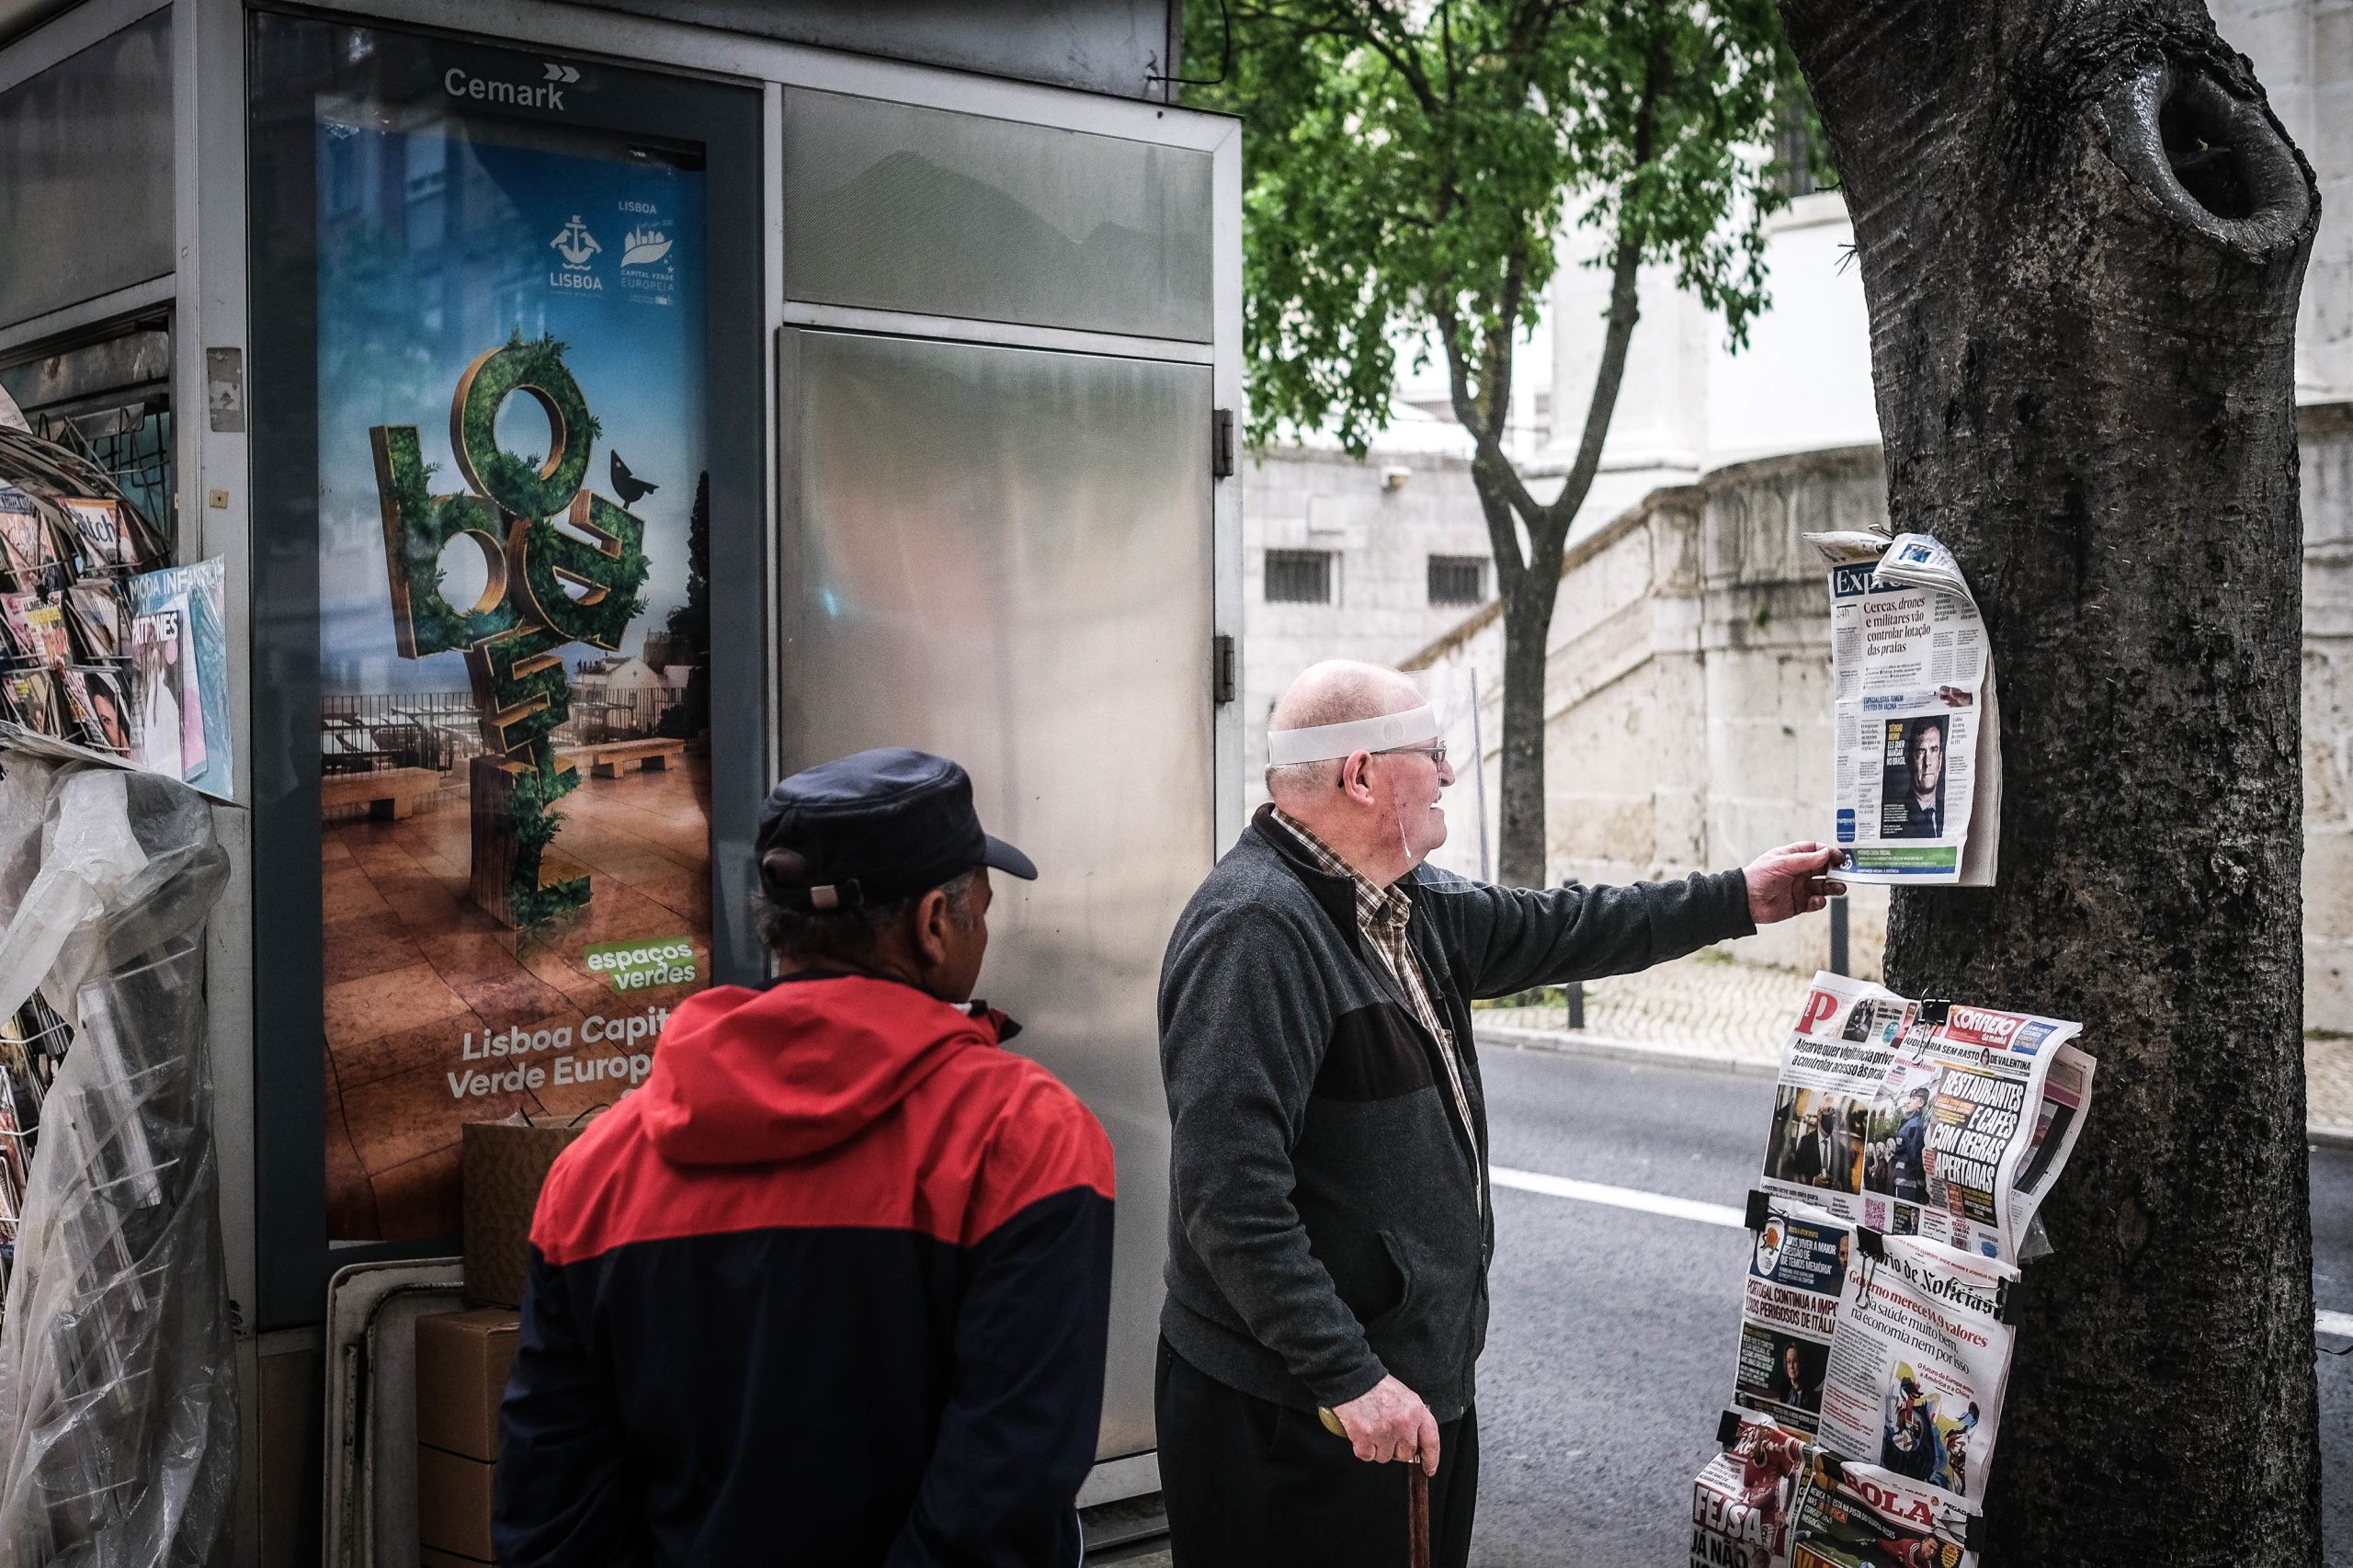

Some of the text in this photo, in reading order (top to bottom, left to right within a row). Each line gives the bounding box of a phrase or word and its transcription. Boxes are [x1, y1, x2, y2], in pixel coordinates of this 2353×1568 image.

[445, 67, 564, 111] Cemark
[619, 200, 657, 214] LISBOA
[550, 272, 603, 290] LISBOA
[129, 576, 161, 601] MODA
[1863, 600, 1898, 614] Cercas,
[1899, 596, 1926, 609] drones
[1866, 610, 1925, 628] e militares vão
[1867, 623, 1931, 642] controlar lotação
[1867, 641, 1907, 656] das praias
[587, 942, 693, 971] espaços
[614, 964, 697, 991] verdes
[1794, 990, 1838, 1035] P
[1954, 1007, 2017, 1037] CORREIO
[462, 1025, 573, 1061] Lisboa
[1793, 1038, 1823, 1054] Algarve
[1821, 1043, 1841, 1059] quer
[1839, 1045, 1874, 1062] vigilância
[1792, 1056, 1797, 1066] a
[1796, 1054, 1834, 1073] controlar
[1832, 1062, 1858, 1075] acesso
[1857, 1064, 1868, 1078] às
[1941, 1044, 1959, 1056] SEM
[1957, 1049, 1980, 1062] RASTO
[1989, 1055, 1998, 1065] DE
[1997, 1056, 2031, 1071] VALENTINA
[447, 1052, 654, 1099] Verde Europ
[1940, 1070, 2024, 1113] RESTAURANTES
[1967, 1105, 1984, 1130] E
[1975, 1108, 2018, 1140] CAFÉS
[1931, 1122, 1962, 1153] COM
[1956, 1129, 2006, 1165] REGRAS
[1934, 1152, 1995, 1194] APERTADAS
[1788, 1256, 1805, 1269] TEMOS
[1818, 1242, 1836, 1256] MAIOR
[1904, 1259, 1919, 1283] de
[1747, 1278, 1773, 1301] PORTUGAL
[1774, 1288, 1810, 1310] CONTINUA
[1810, 1297, 1816, 1312] A
[1759, 1300, 1801, 1325] PERIGOSOS
[1801, 1312, 1811, 1329] DE
[1848, 1270, 1890, 1299] Governo
[1890, 1290, 1928, 1321] merece
[1945, 1321, 1989, 1349] valores
[1850, 1307, 1970, 1374] na economia nem por isso
[1878, 1302, 1908, 1325] saúde
[1908, 1316, 1938, 1340] muito
[1938, 1331, 1960, 1355] bem,
[1922, 1364, 1939, 1376] futuro
[1938, 1371, 1946, 1380] da
[1945, 1375, 1962, 1388] Europa
[1923, 1373, 1947, 1388] América
[1955, 1388, 1971, 1399] China
[1806, 1495, 1847, 1522] MAS BFICA
[1841, 1470, 1938, 1528] BOLA
[1693, 1484, 1763, 1546] FEJSA
[1849, 1507, 1862, 1521] PISTA
[1691, 1528, 1707, 1559] JÁ
